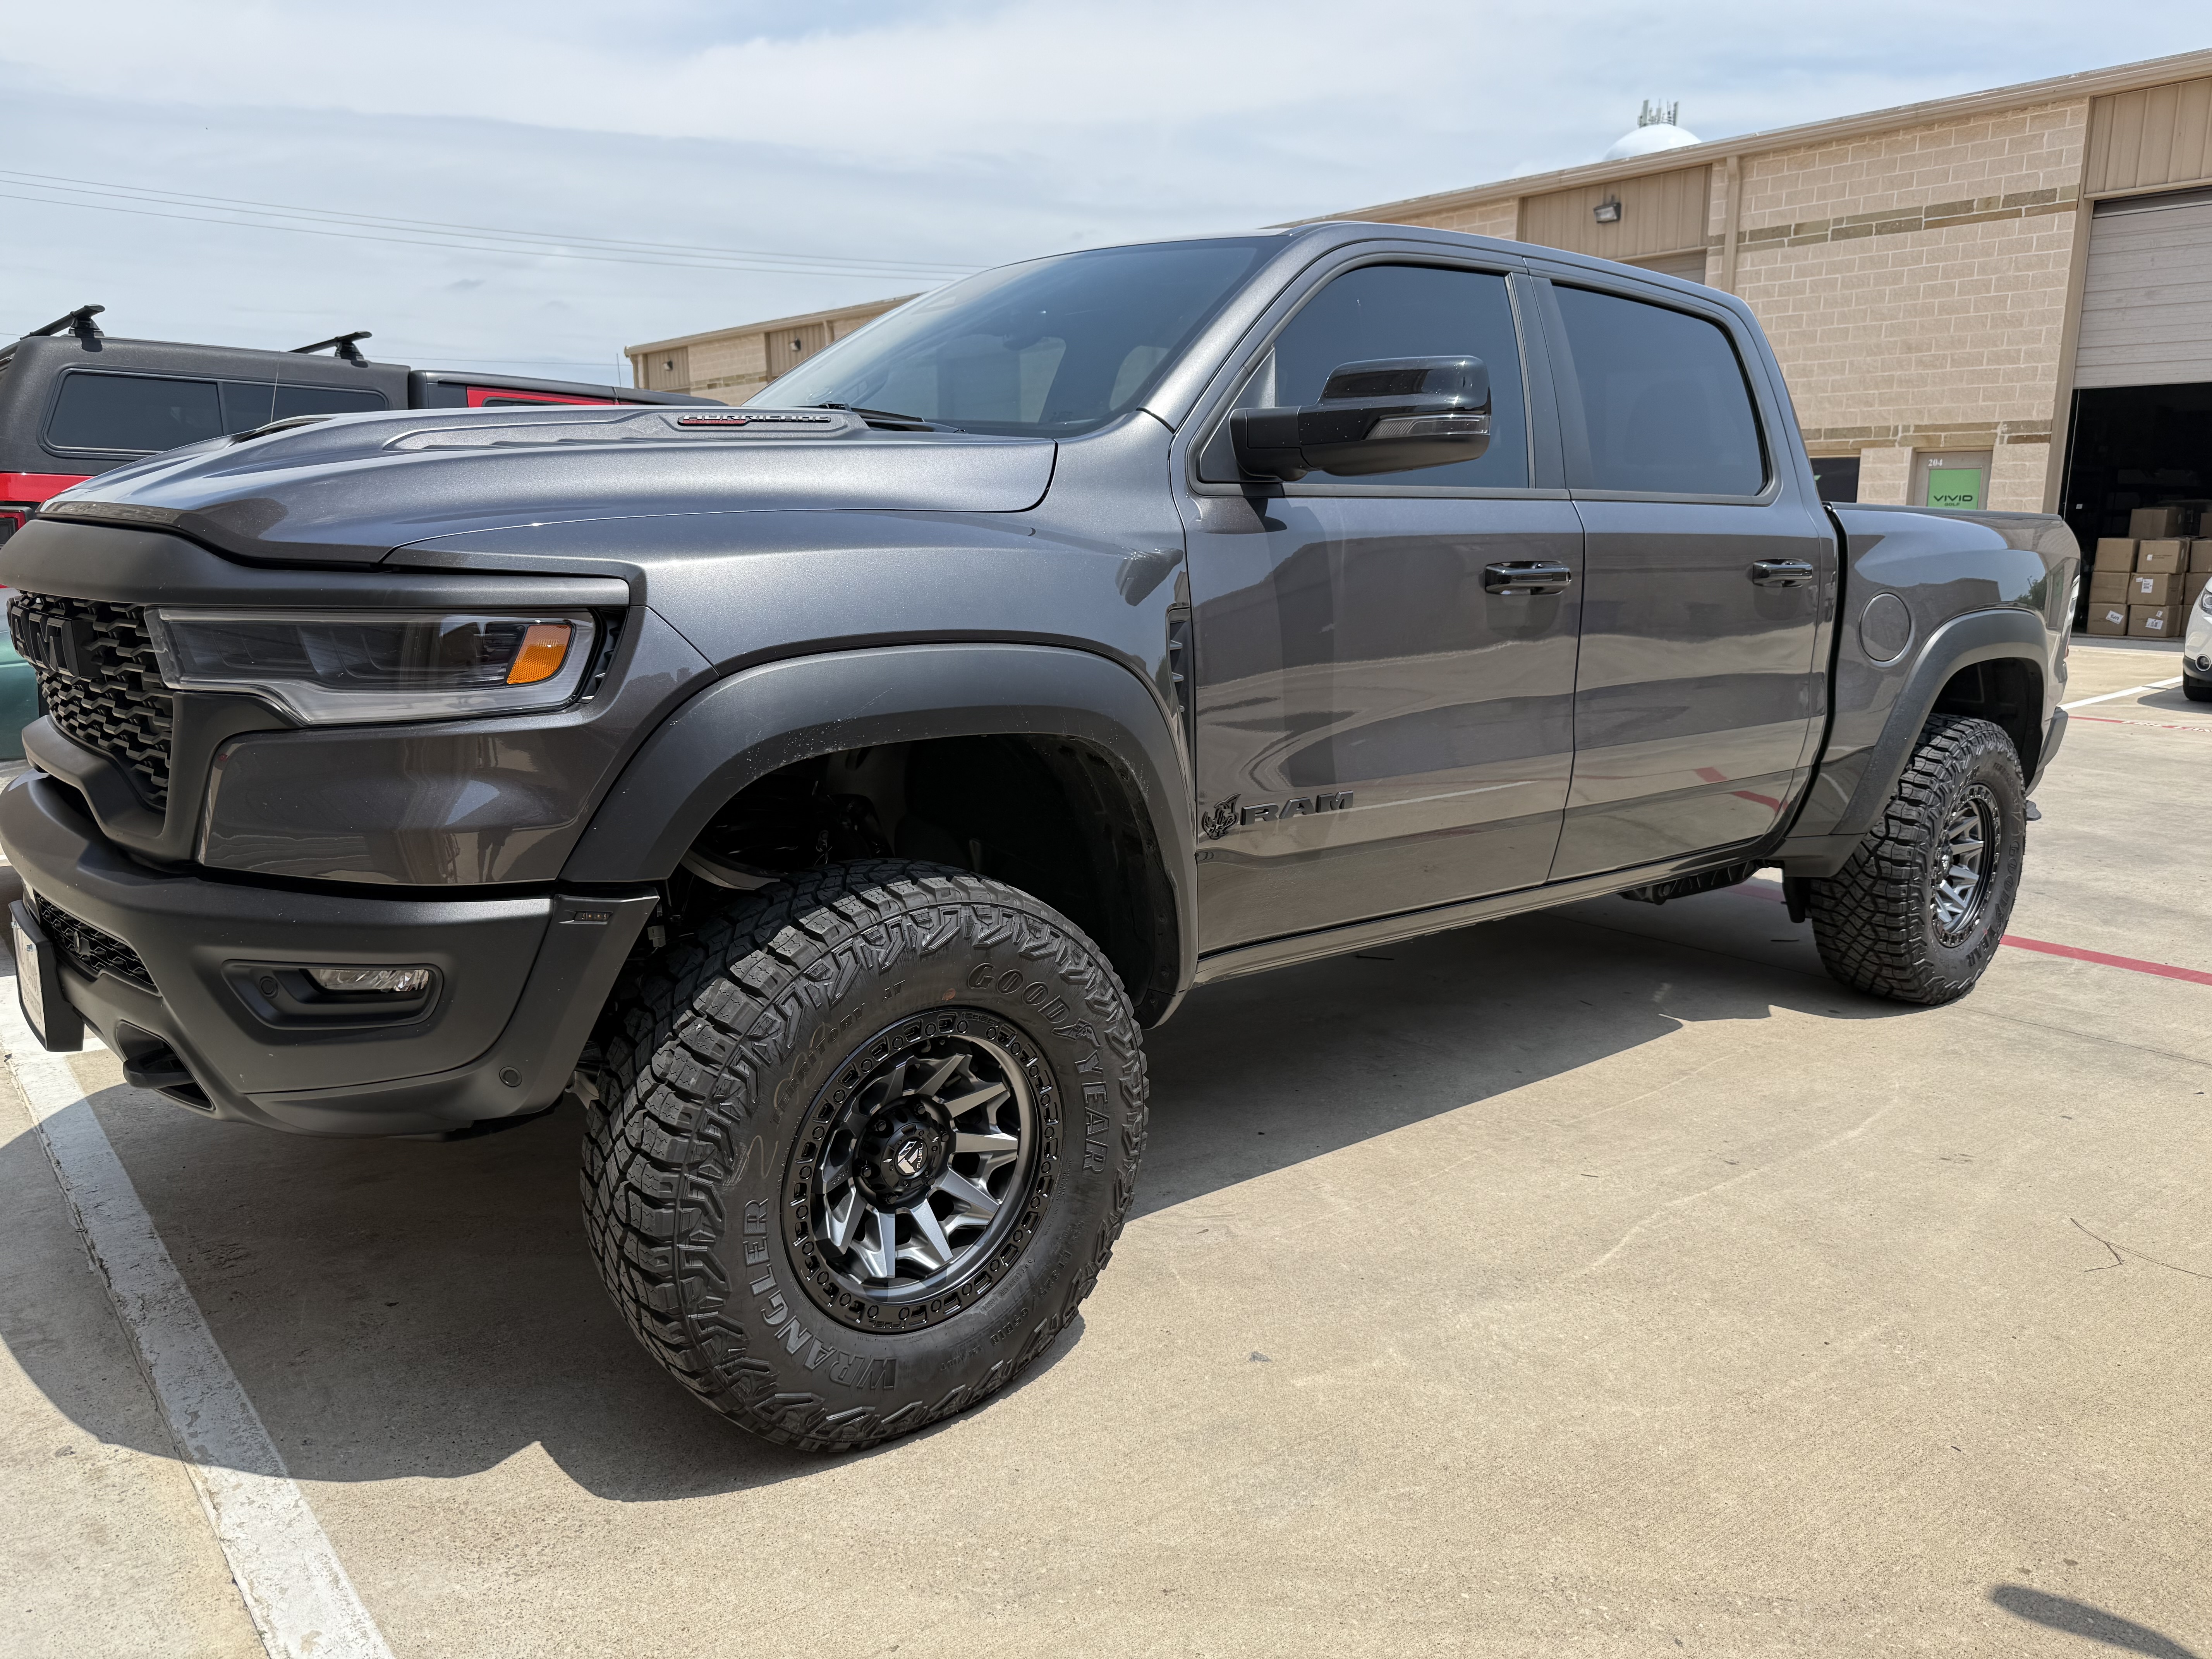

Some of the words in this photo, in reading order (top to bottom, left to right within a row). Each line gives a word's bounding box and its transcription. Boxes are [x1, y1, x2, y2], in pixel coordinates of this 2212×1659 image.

[1240, 790, 1353, 826] RAM
[770, 1003, 865, 1125] TERRITORY
[881, 980, 905, 1003] AT
[968, 962, 1109, 1174] GOODYEAR
[743, 1198, 897, 1391] WRANGLER
